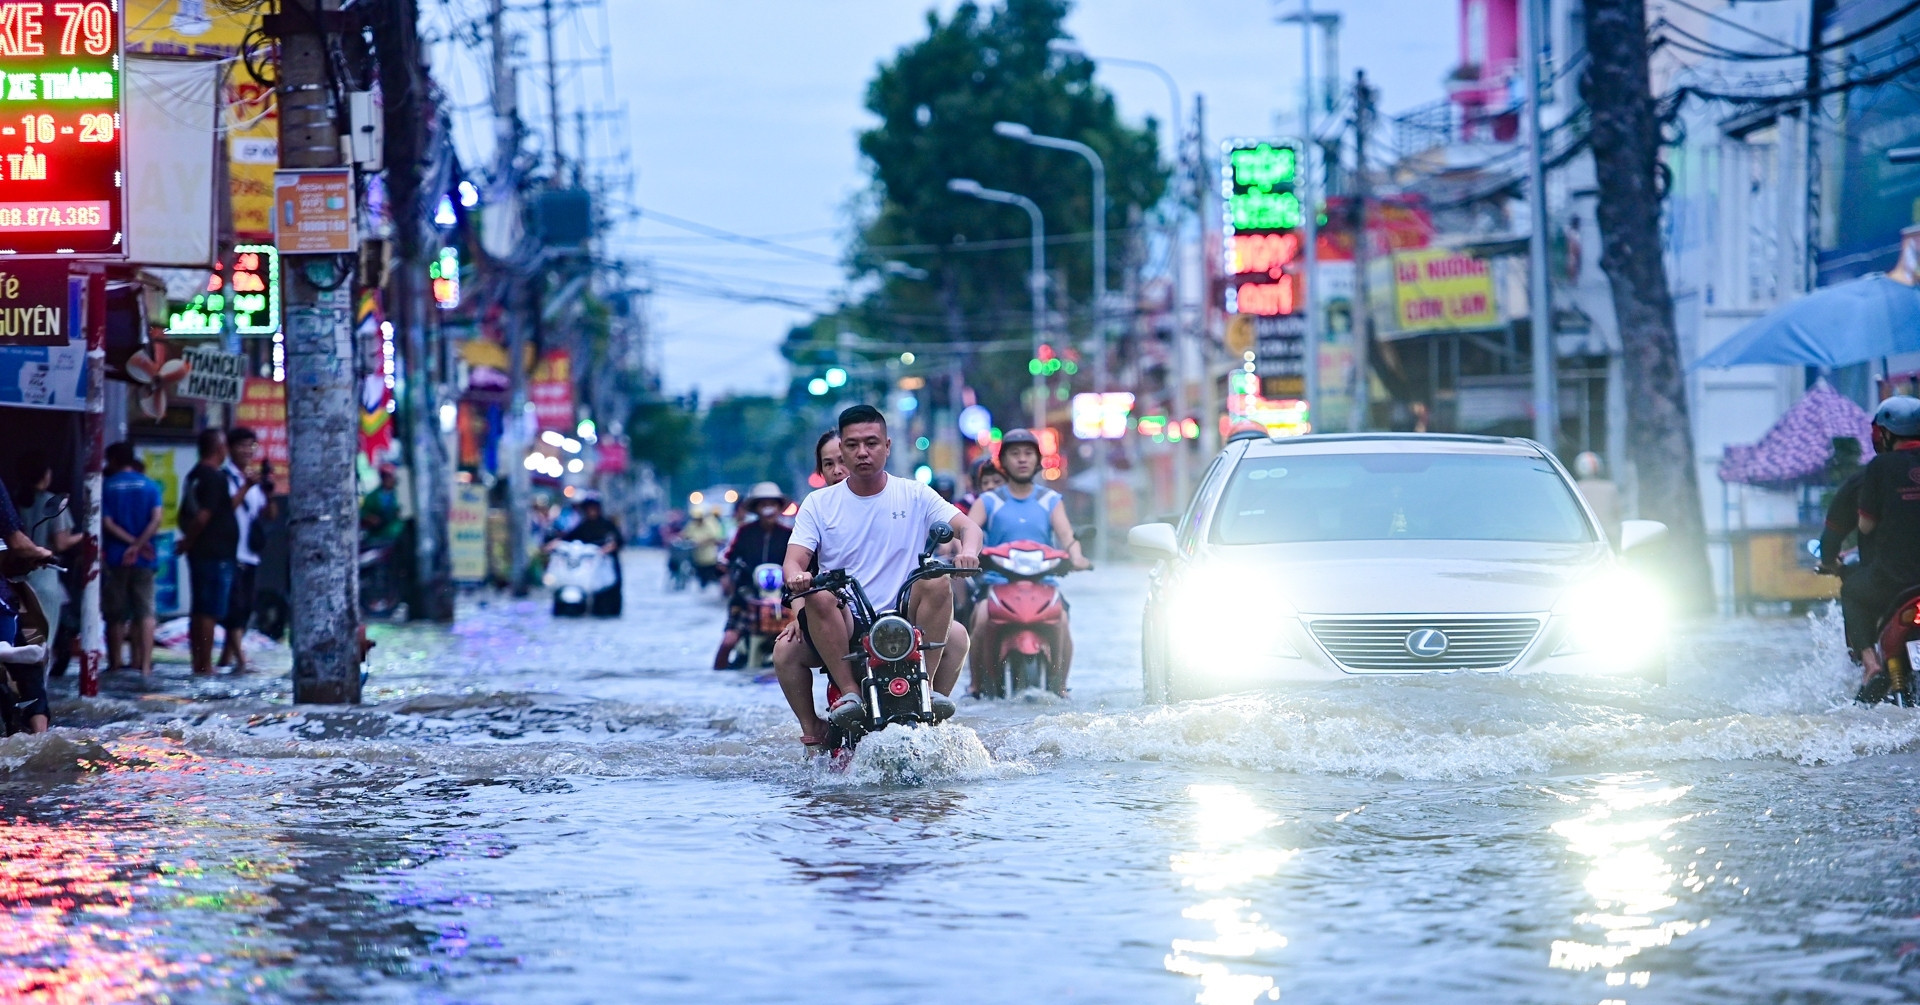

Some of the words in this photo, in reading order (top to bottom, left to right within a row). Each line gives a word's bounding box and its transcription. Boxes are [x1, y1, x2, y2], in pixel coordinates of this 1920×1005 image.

[54, 1, 112, 55] 79
[7, 72, 38, 100] XE
[39, 66, 114, 100] THÁNG
[21, 114, 56, 143] 16
[78, 113, 114, 143] 29
[6, 145, 47, 180] TẢI
[0, 206, 101, 226] 08.874.385
